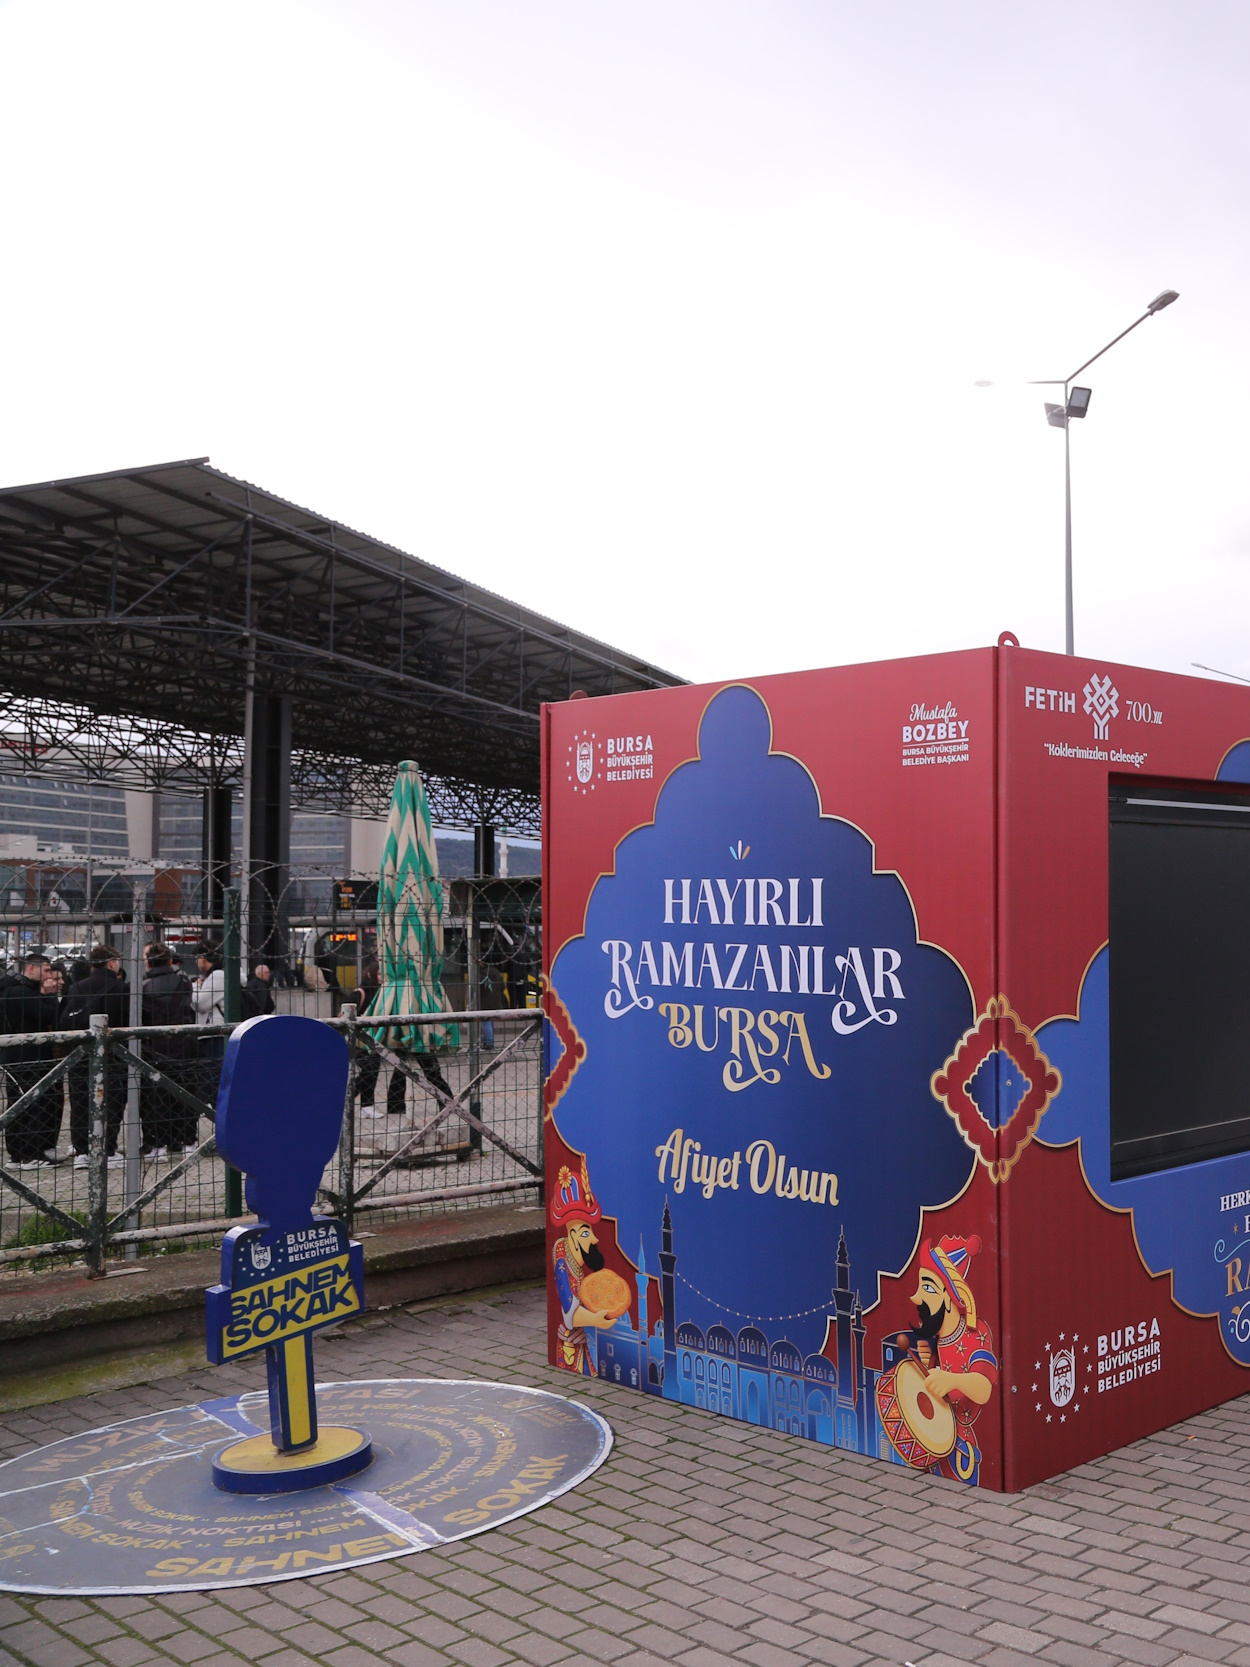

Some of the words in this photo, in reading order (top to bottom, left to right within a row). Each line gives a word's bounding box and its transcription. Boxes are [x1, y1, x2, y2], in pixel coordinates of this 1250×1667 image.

[909, 700, 958, 724] Mustafa
[607, 735, 654, 754] BURSA
[902, 720, 969, 743] BOZBEY
[902, 748, 925, 756] BURSA
[926, 742, 969, 754] BÜYÜKŞEHİR
[902, 756, 936, 766] BELEDİYE
[937, 754, 969, 765] BAŞKANI
[607, 765, 654, 781] BELEDİYESİ
[663, 877, 825, 928] HAYIRLI
[601, 939, 906, 1035] RAMAZANLAR
[658, 1002, 832, 1092] BURSA
[655, 1128, 742, 1199] Afiyet
[745, 1140, 840, 1206] Olsun
[286, 1224, 338, 1246] BURSA
[288, 1243, 340, 1263] BELEDİYESİ
[231, 1263, 352, 1318] SAHNEM
[226, 1280, 353, 1348] SOKAK
[1097, 1317, 1161, 1357] BURSA
[1098, 1354, 1161, 1394] BELEDİYESİ
[400, 1485, 469, 1514] OKAK
[443, 1453, 569, 1526] SOKAK
[213, 1510, 295, 1523] SAHNEM
[298, 1500, 353, 1516] SOKA
[91, 1532, 193, 1550] SOKAK
[179, 1519, 302, 1537] NOKTASI
[222, 1518, 367, 1549] SAHNEM
